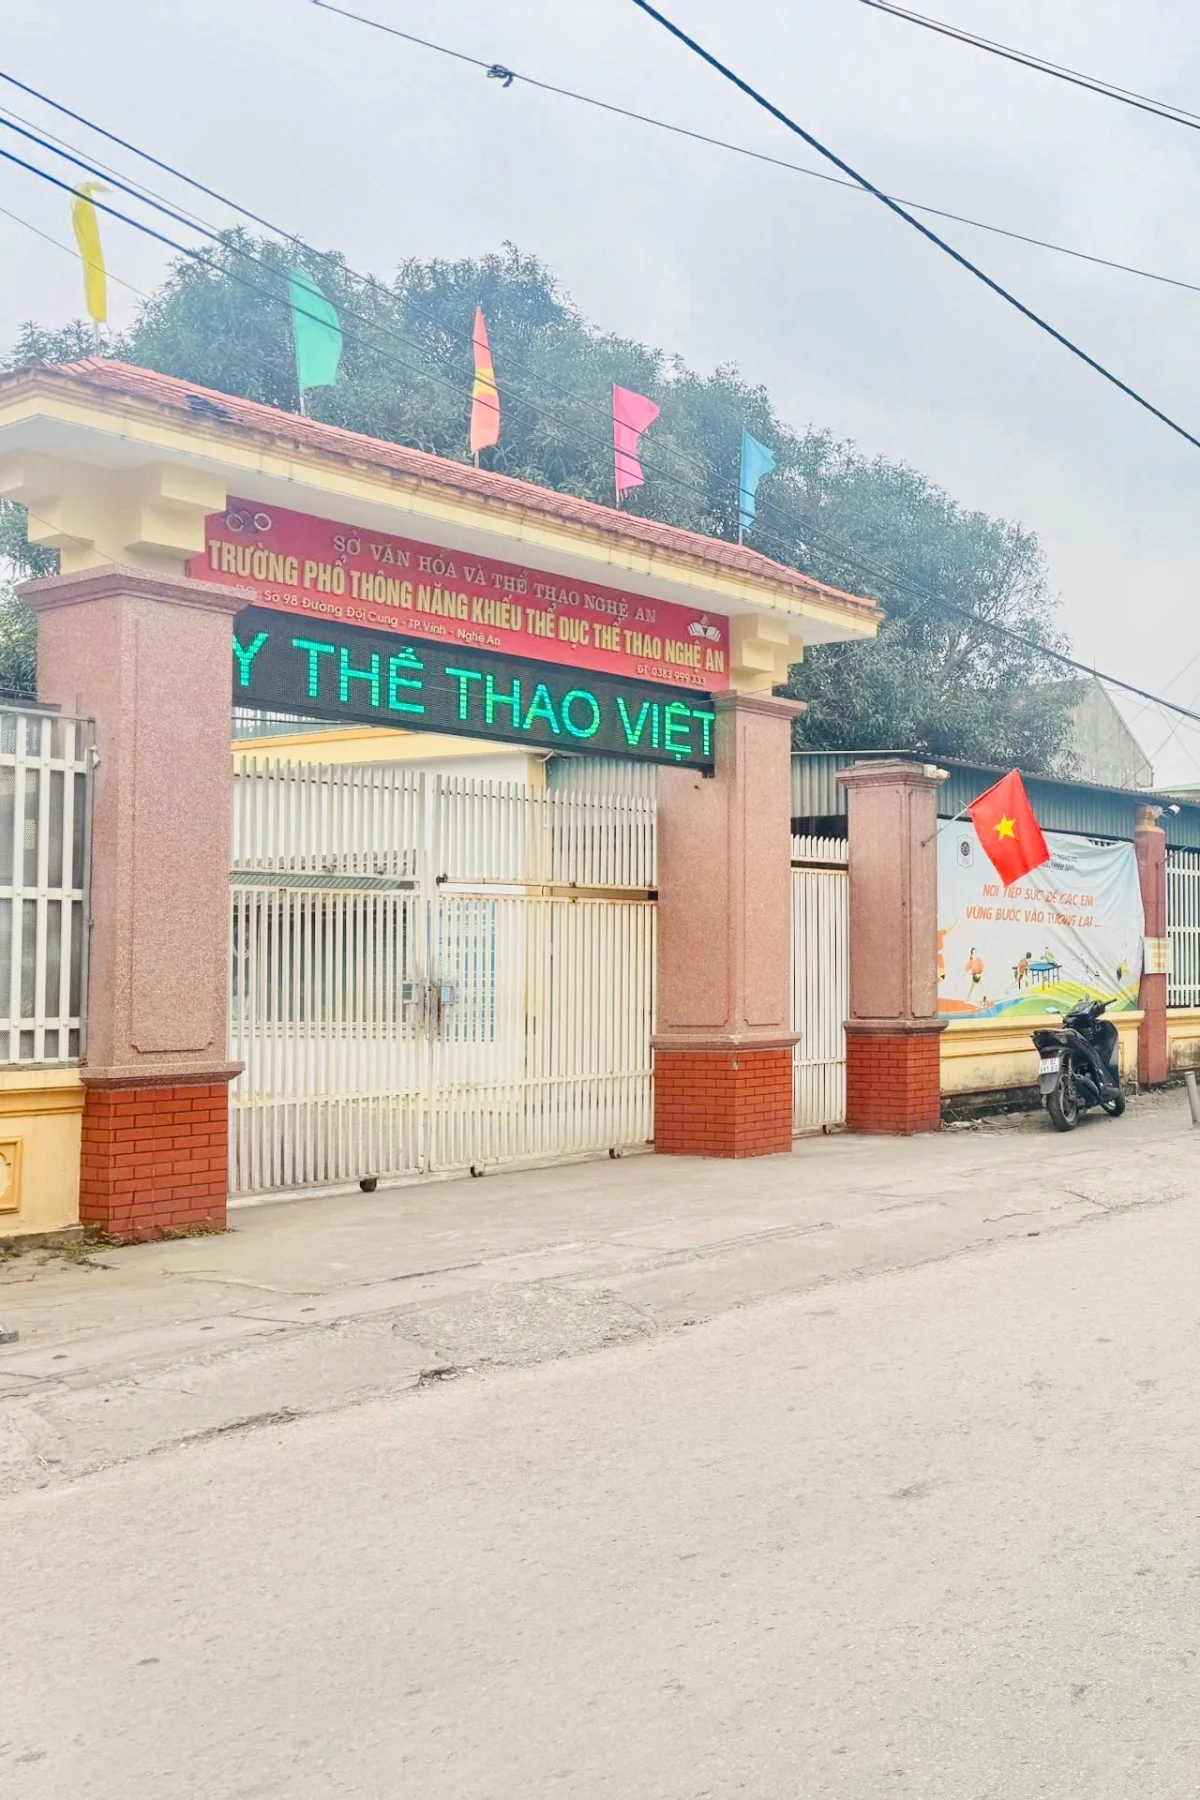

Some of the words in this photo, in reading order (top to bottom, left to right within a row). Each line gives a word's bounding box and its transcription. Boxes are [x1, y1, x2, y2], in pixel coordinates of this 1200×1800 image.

[208, 540, 299, 586] TRƯỜNG
[303, 555, 346, 595] PHỔ
[350, 569, 413, 609] THÔNG
[417, 581, 468, 621] NĂNG
[471, 594, 522, 631] KHIẾU
[525, 603, 556, 639] THỂ
[559, 614, 589, 650] DỤC
[592, 617, 623, 652] THỂ
[623, 629, 661, 660] THAO
[664, 640, 702, 672] NGHỆ
[705, 649, 725, 673] AN
[333, 530, 361, 555] SỞ
[370, 542, 411, 567] VĂN
[418, 554, 457, 578] HÓA
[463, 563, 486, 586] VÀ
[491, 569, 527, 594] THỂ
[534, 582, 580, 606] THAO
[635, 606, 656, 624] AN
[283, 594, 298, 606] 98
[368, 611, 398, 628] Cung
[487, 635, 500, 646] An
[231, 631, 270, 687] Y
[291, 637, 426, 715] THỂ
[445, 667, 601, 738] THAO
[616, 697, 716, 761] VIỆT
[1024, 908, 1044, 923] VÀO
[1078, 915, 1093, 927] LAI
[1080, 894, 1094, 906] EM
